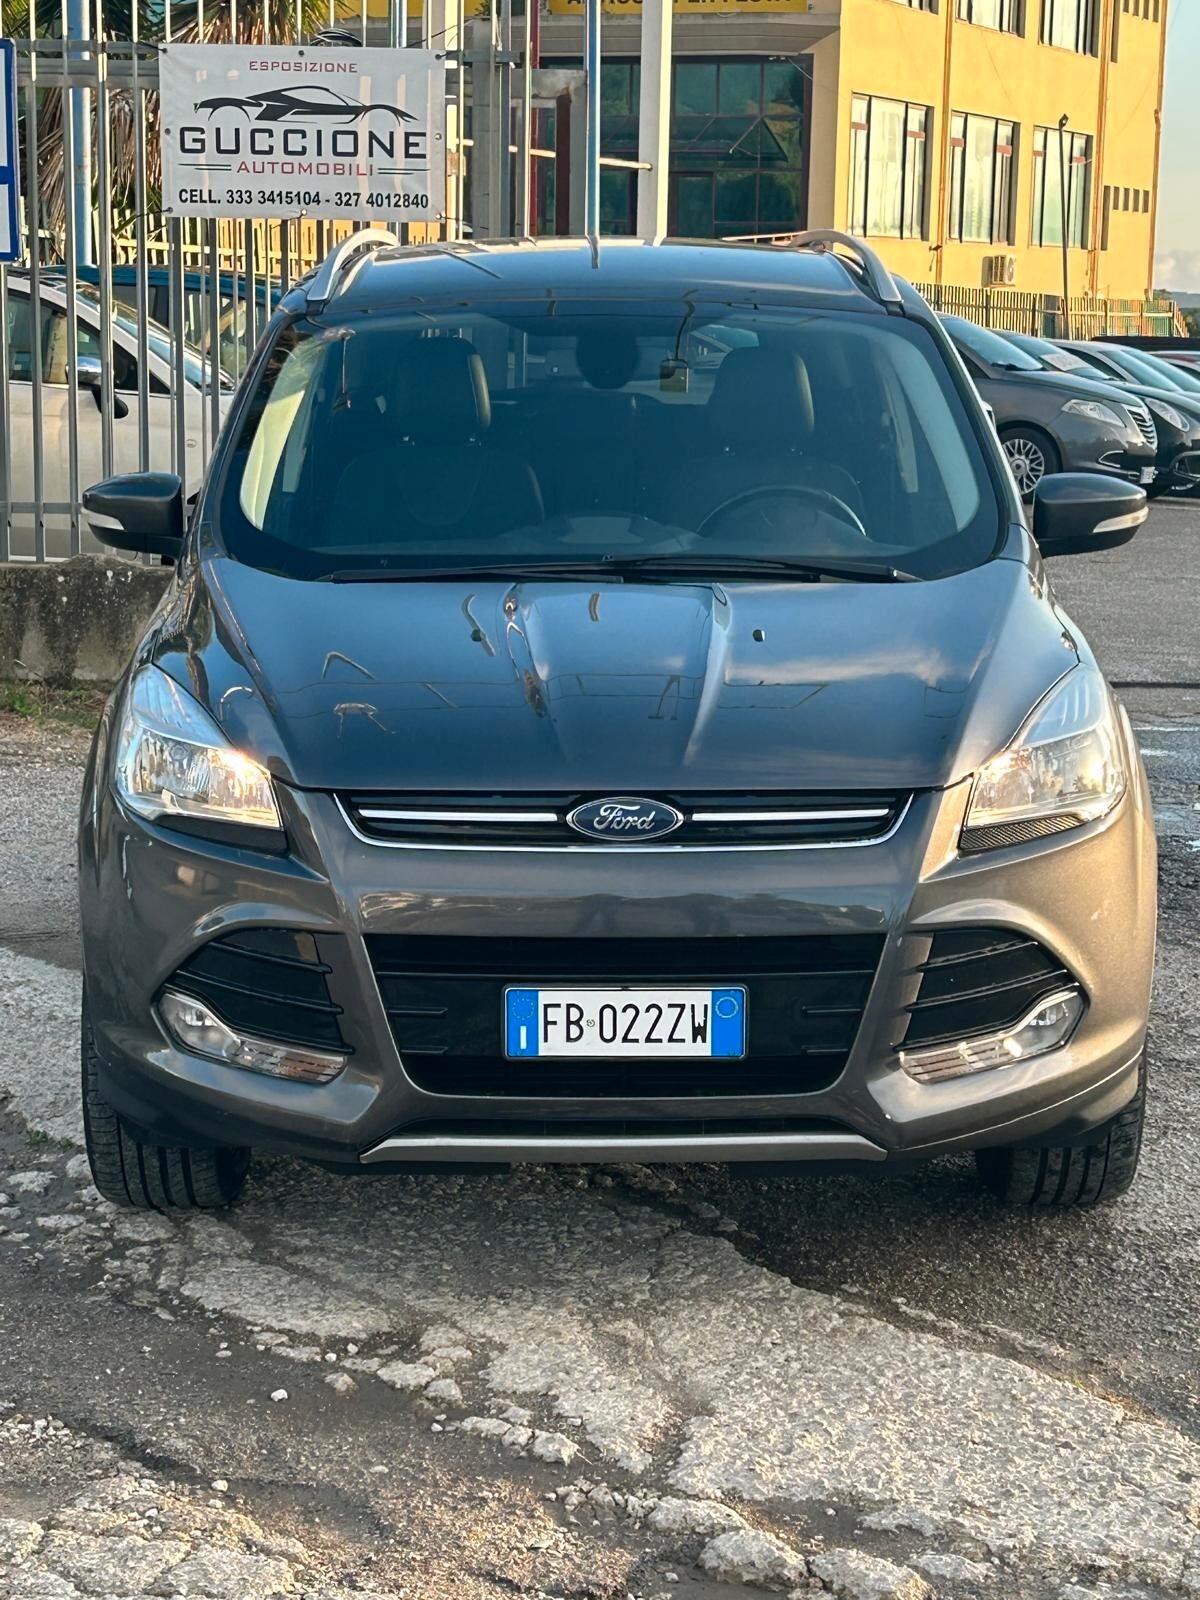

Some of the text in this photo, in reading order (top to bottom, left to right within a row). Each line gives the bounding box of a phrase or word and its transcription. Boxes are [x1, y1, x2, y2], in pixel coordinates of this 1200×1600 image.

[249, 61, 358, 73] ESPOSIZIONE
[179, 126, 427, 159] GUCCIONE
[236, 161, 374, 176] AUTOMOBILI
[178, 188, 221, 204] CELL.
[226, 190, 253, 204] 333
[257, 190, 320, 206] 3415104
[334, 192, 360, 207] 327
[366, 193, 429, 209] 4012840
[593, 804, 656, 830] Ford
